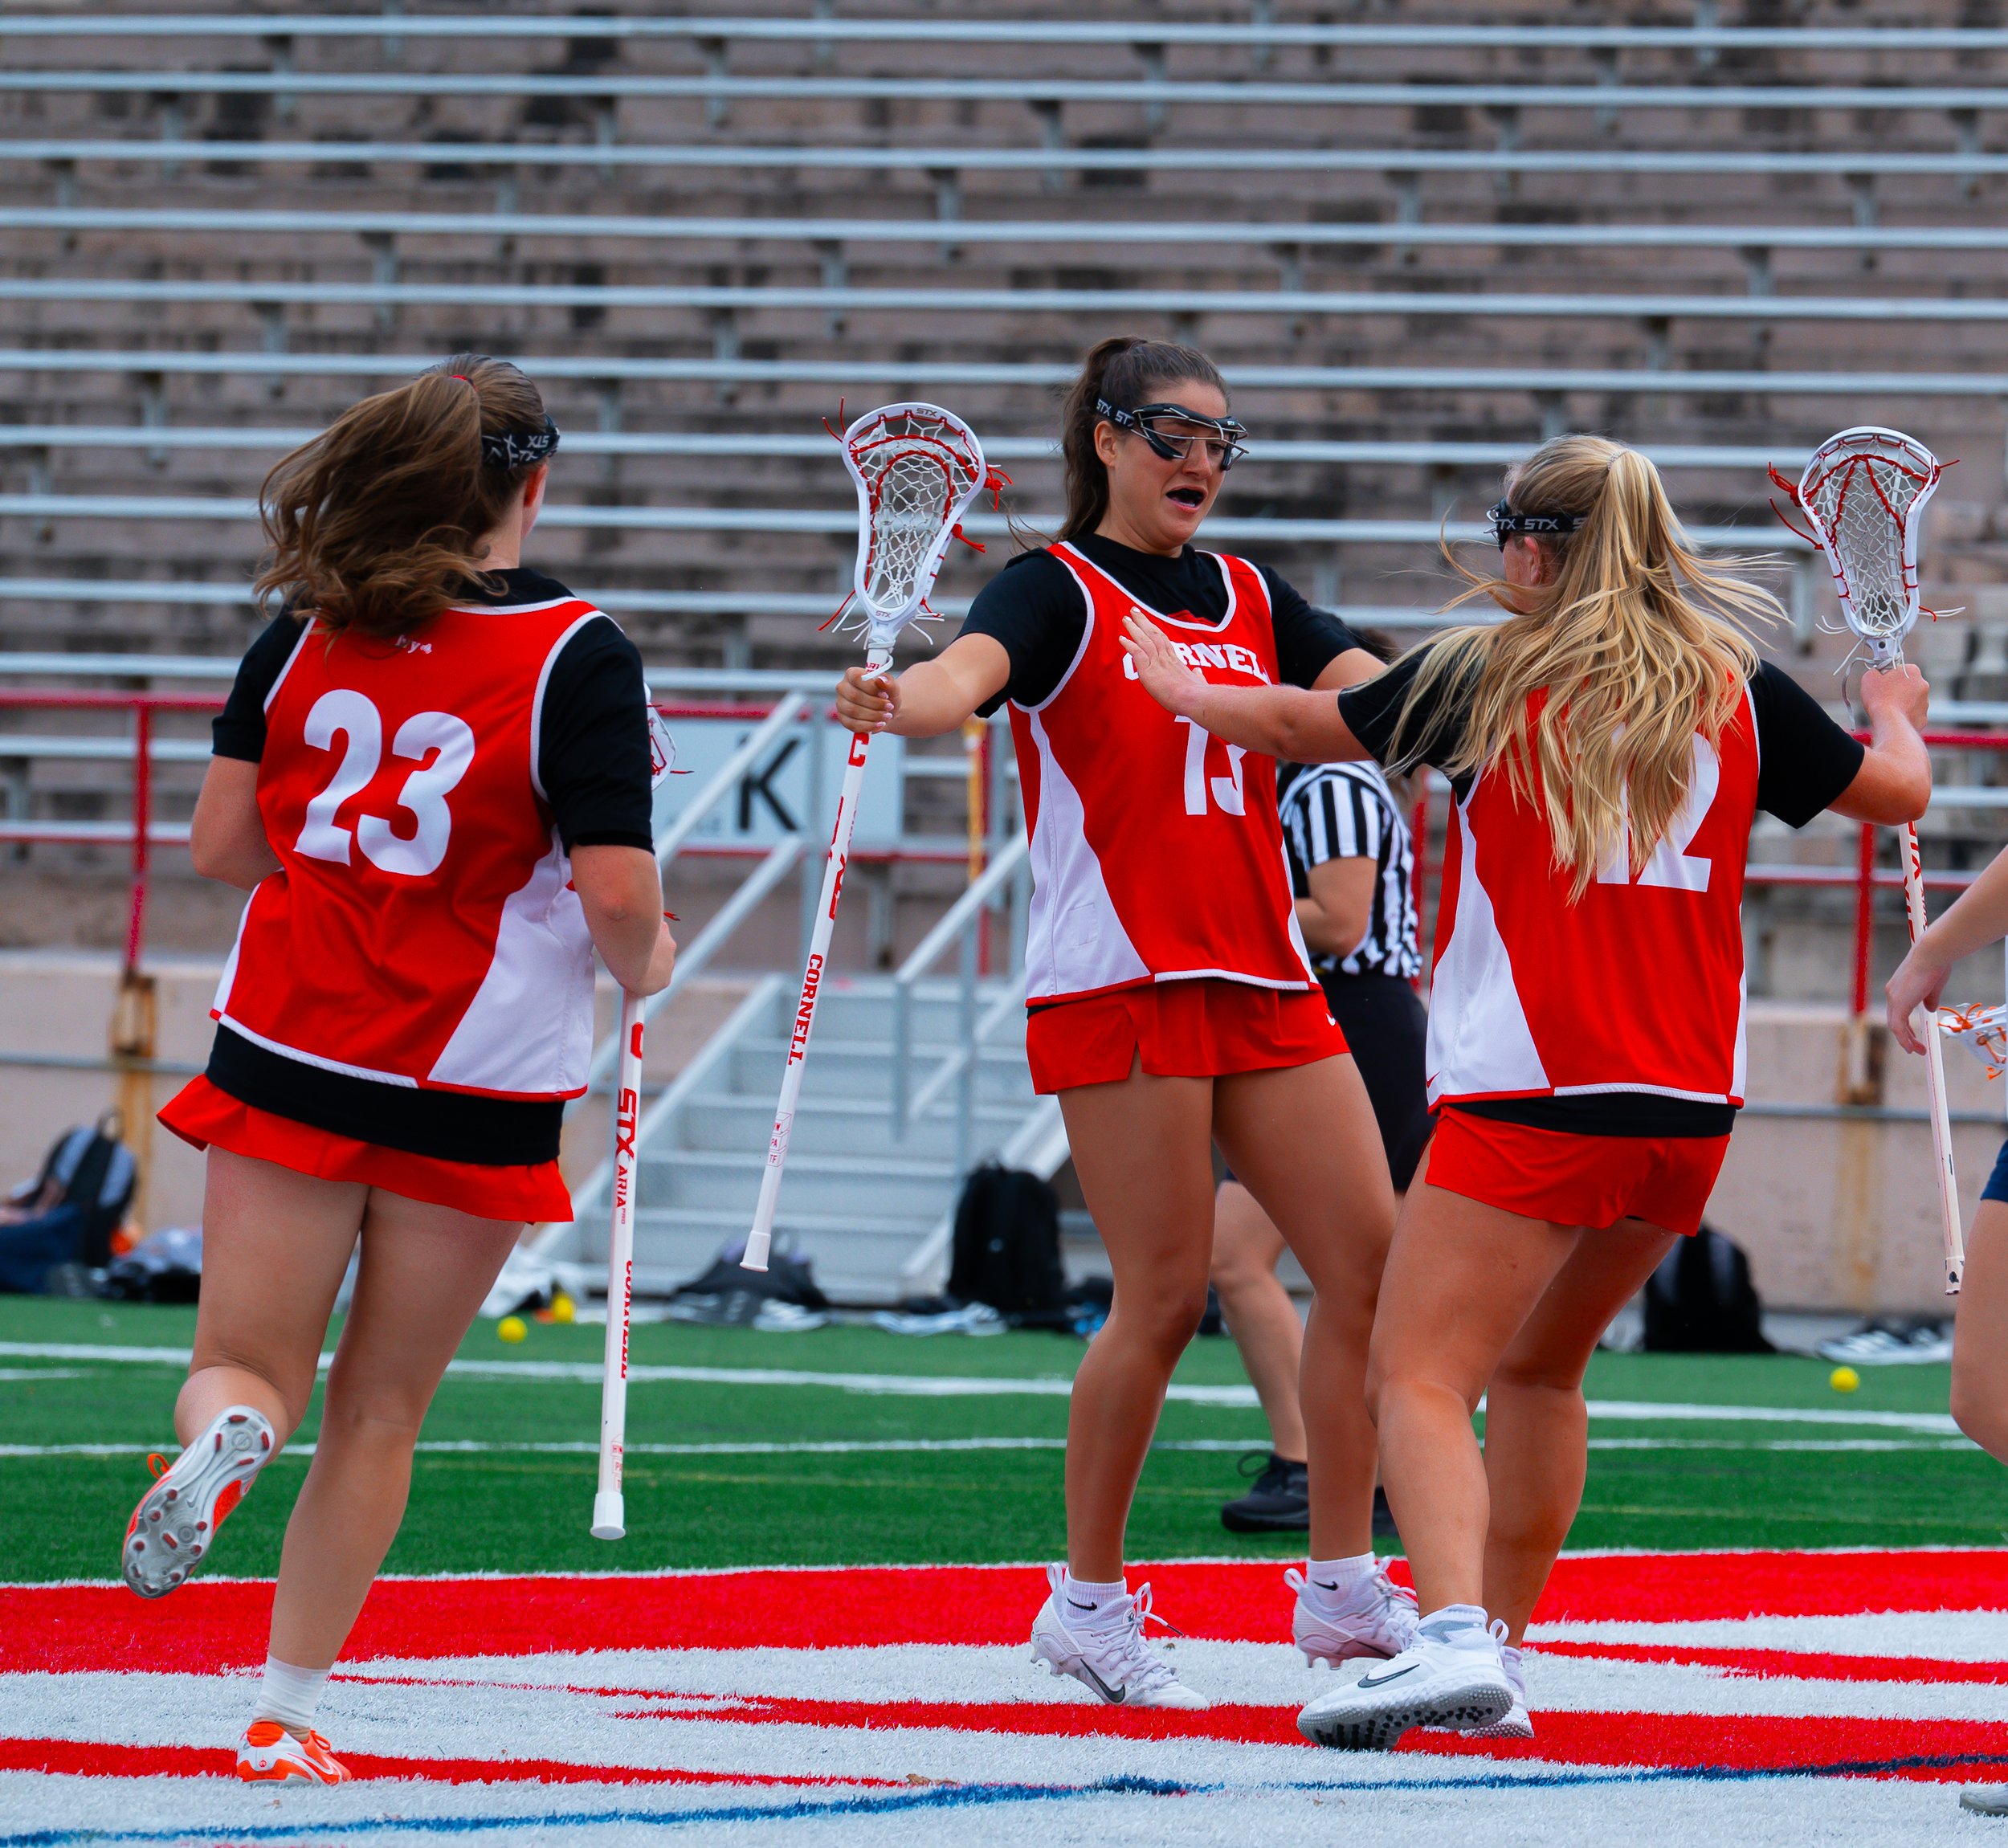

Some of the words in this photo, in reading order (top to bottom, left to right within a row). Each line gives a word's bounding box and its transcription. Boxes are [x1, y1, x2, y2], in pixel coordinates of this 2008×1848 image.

[916, 407, 938, 418] STX
[1096, 398, 1111, 417] STX
[1495, 518, 1516, 530] TX
[1524, 518, 1559, 530] STX
[875, 610, 892, 618] STX
[292, 688, 475, 877] 23
[739, 732, 802, 834] K
[787, 953, 824, 1067] CORNELL
[615, 1087, 637, 1161] STX
[616, 1165, 629, 1209] ARIA
